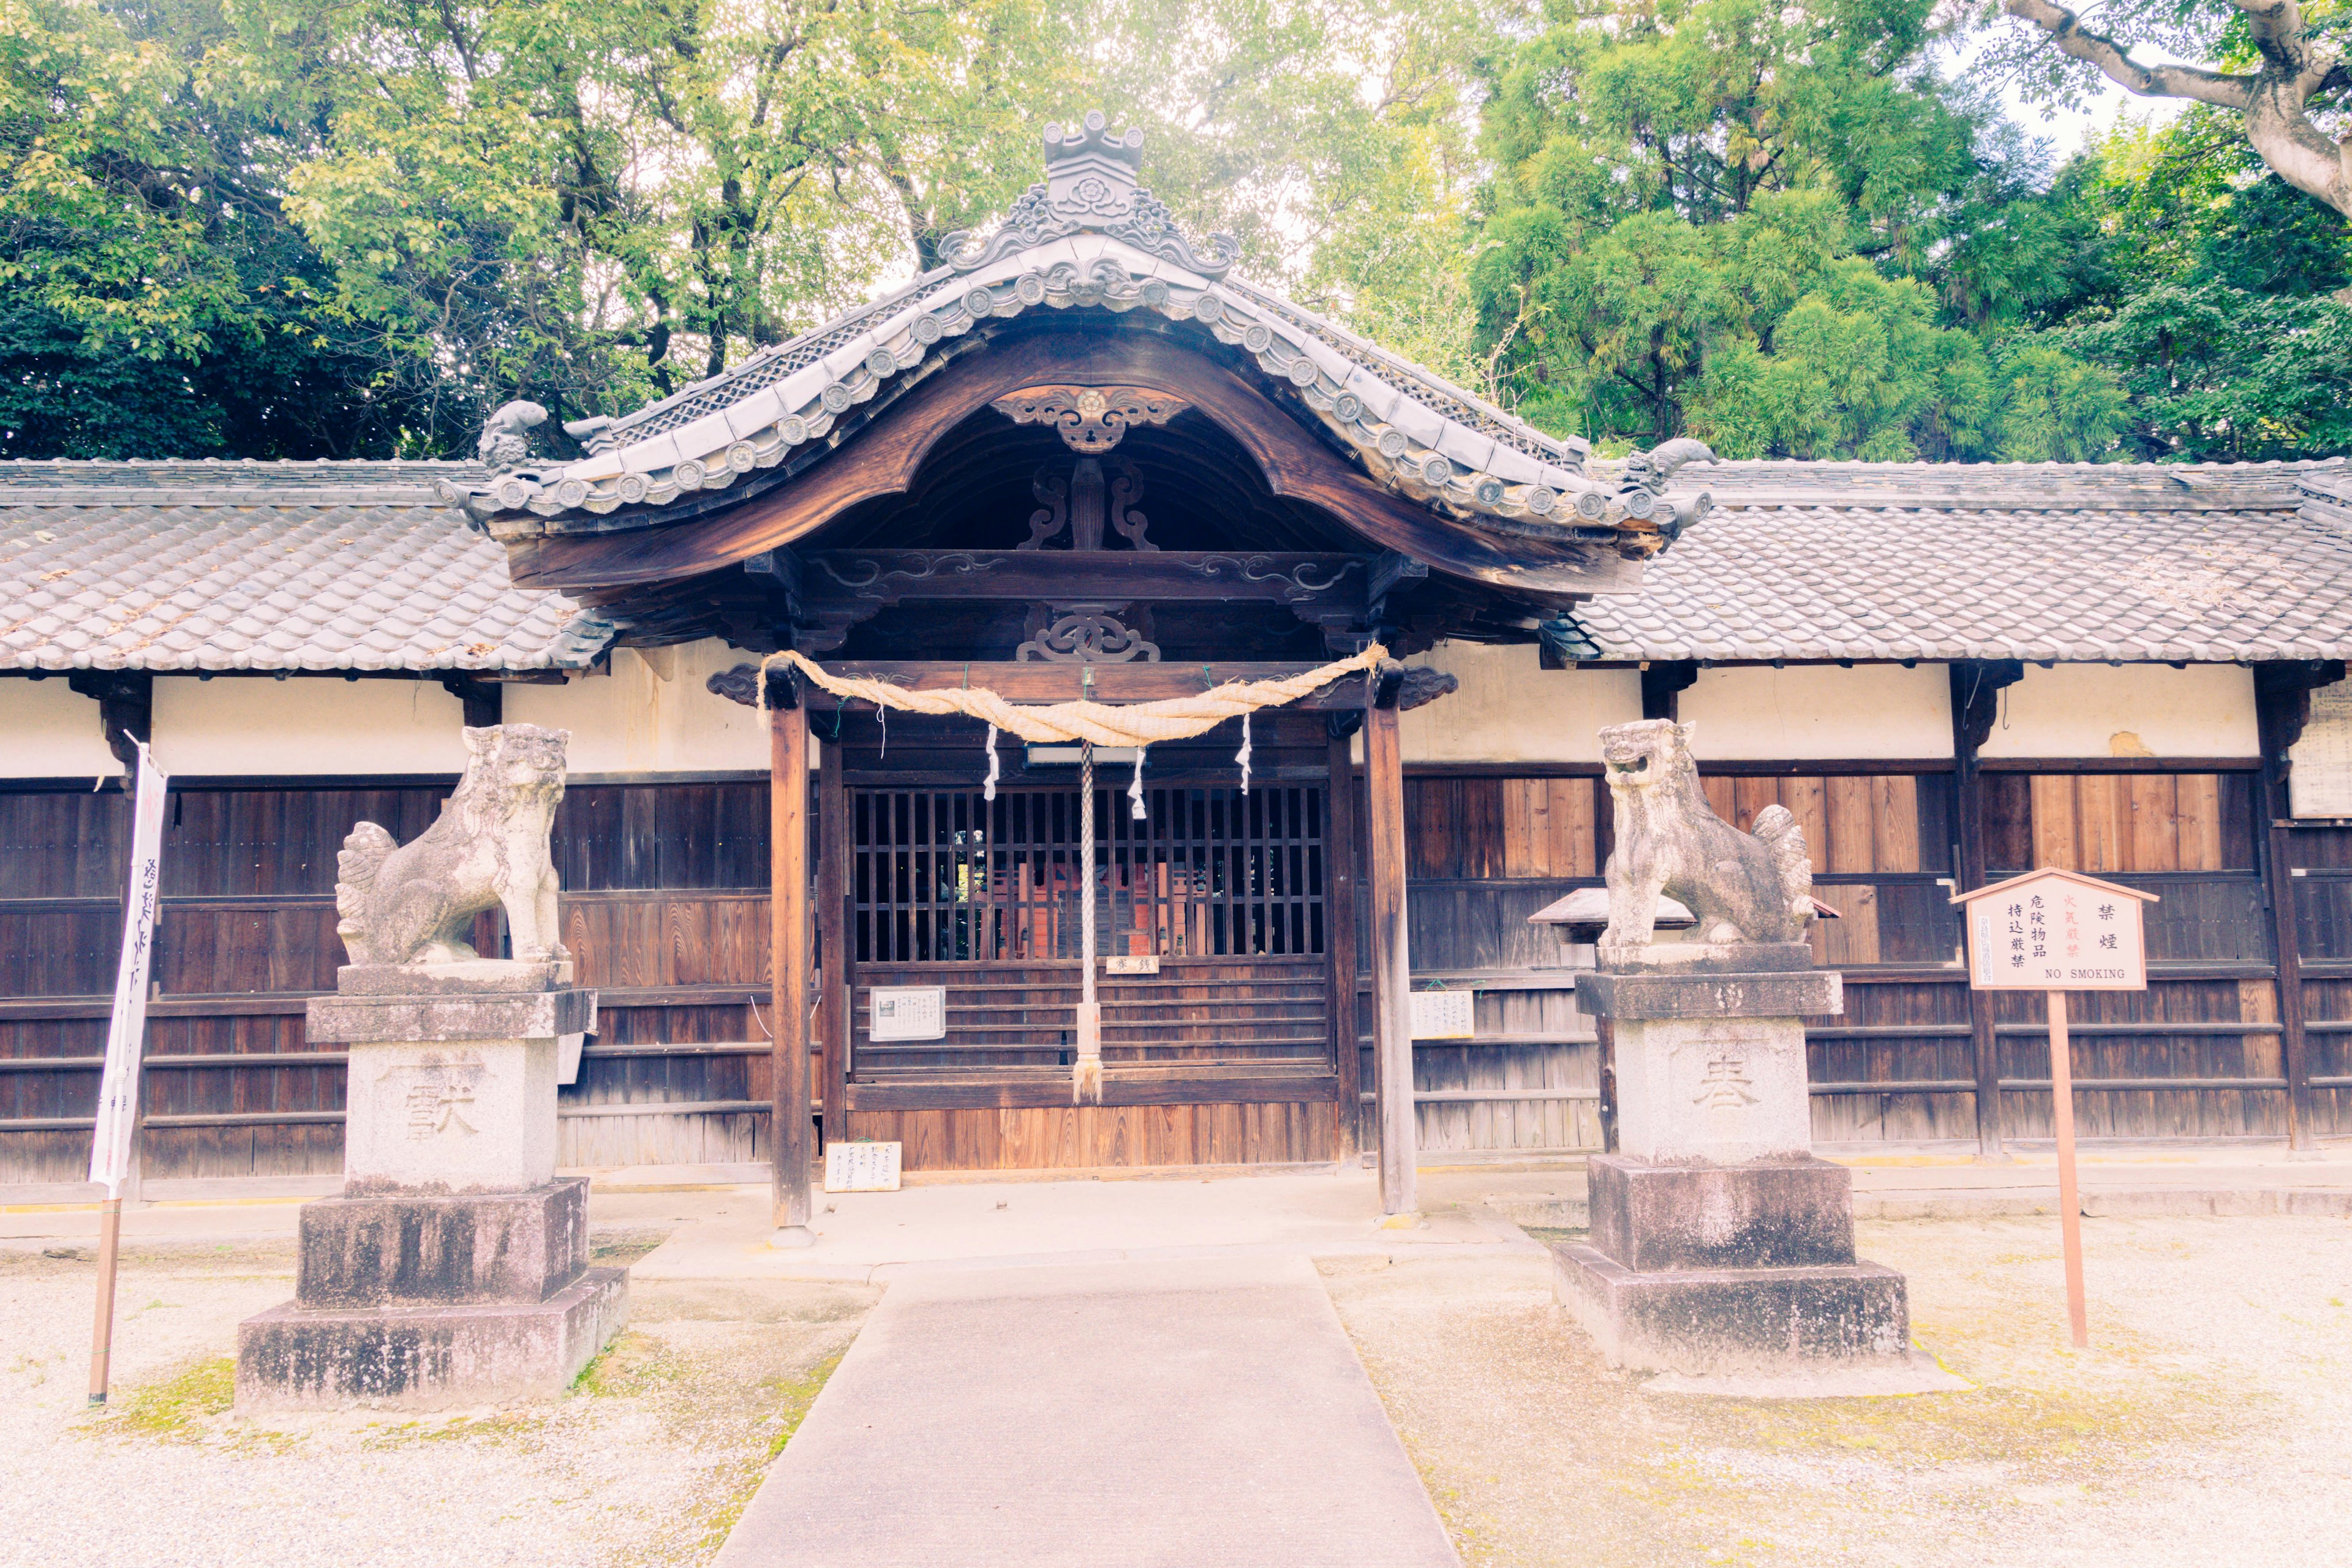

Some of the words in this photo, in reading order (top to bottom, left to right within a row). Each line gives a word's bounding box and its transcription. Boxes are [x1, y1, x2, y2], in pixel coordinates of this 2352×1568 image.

[2008, 903, 2025, 968] 持込厳禁
[2030, 895, 2047, 957] 危険物品
[2064, 894, 2080, 958] 火気厳禁
[2098, 903, 2118, 950] 禁煙
[2045, 969, 2061, 979] NO
[2070, 969, 2125, 979] SMOKING
